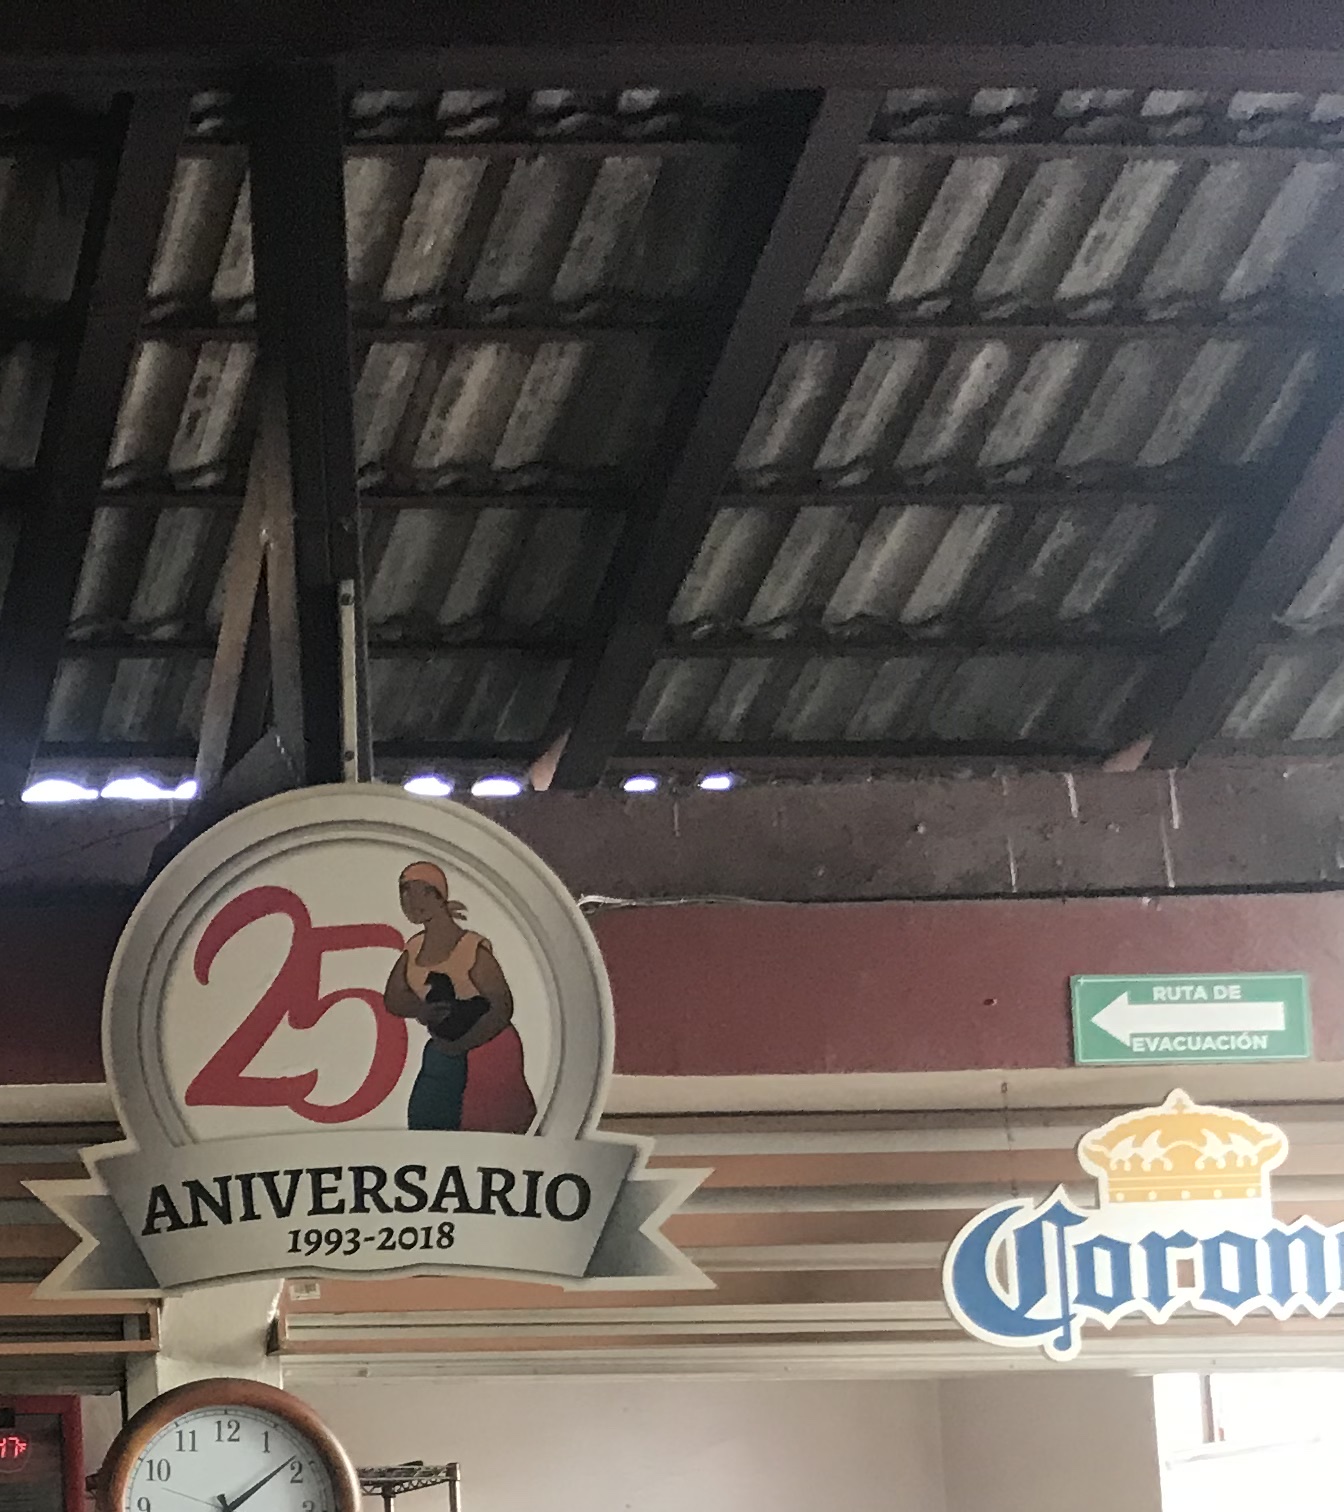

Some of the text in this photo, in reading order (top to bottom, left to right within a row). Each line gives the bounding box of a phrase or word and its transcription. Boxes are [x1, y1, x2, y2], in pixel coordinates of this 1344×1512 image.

[1152, 985, 1242, 1000] RUTA DE
[186, 887, 408, 1122] 25
[1131, 1033, 1268, 1053] EVACUACIÓN
[141, 1164, 591, 1237] ANIVERSARIO
[288, 1222, 454, 1256] 1993-2018
[954, 1203, 1344, 1349] Coron
[176, 1430, 196, 1451] 11
[216, 1419, 242, 1442] 12
[262, 1430, 272, 1453] 1
[147, 1459, 170, 1481] 10
[289, 1461, 303, 1484] 2
